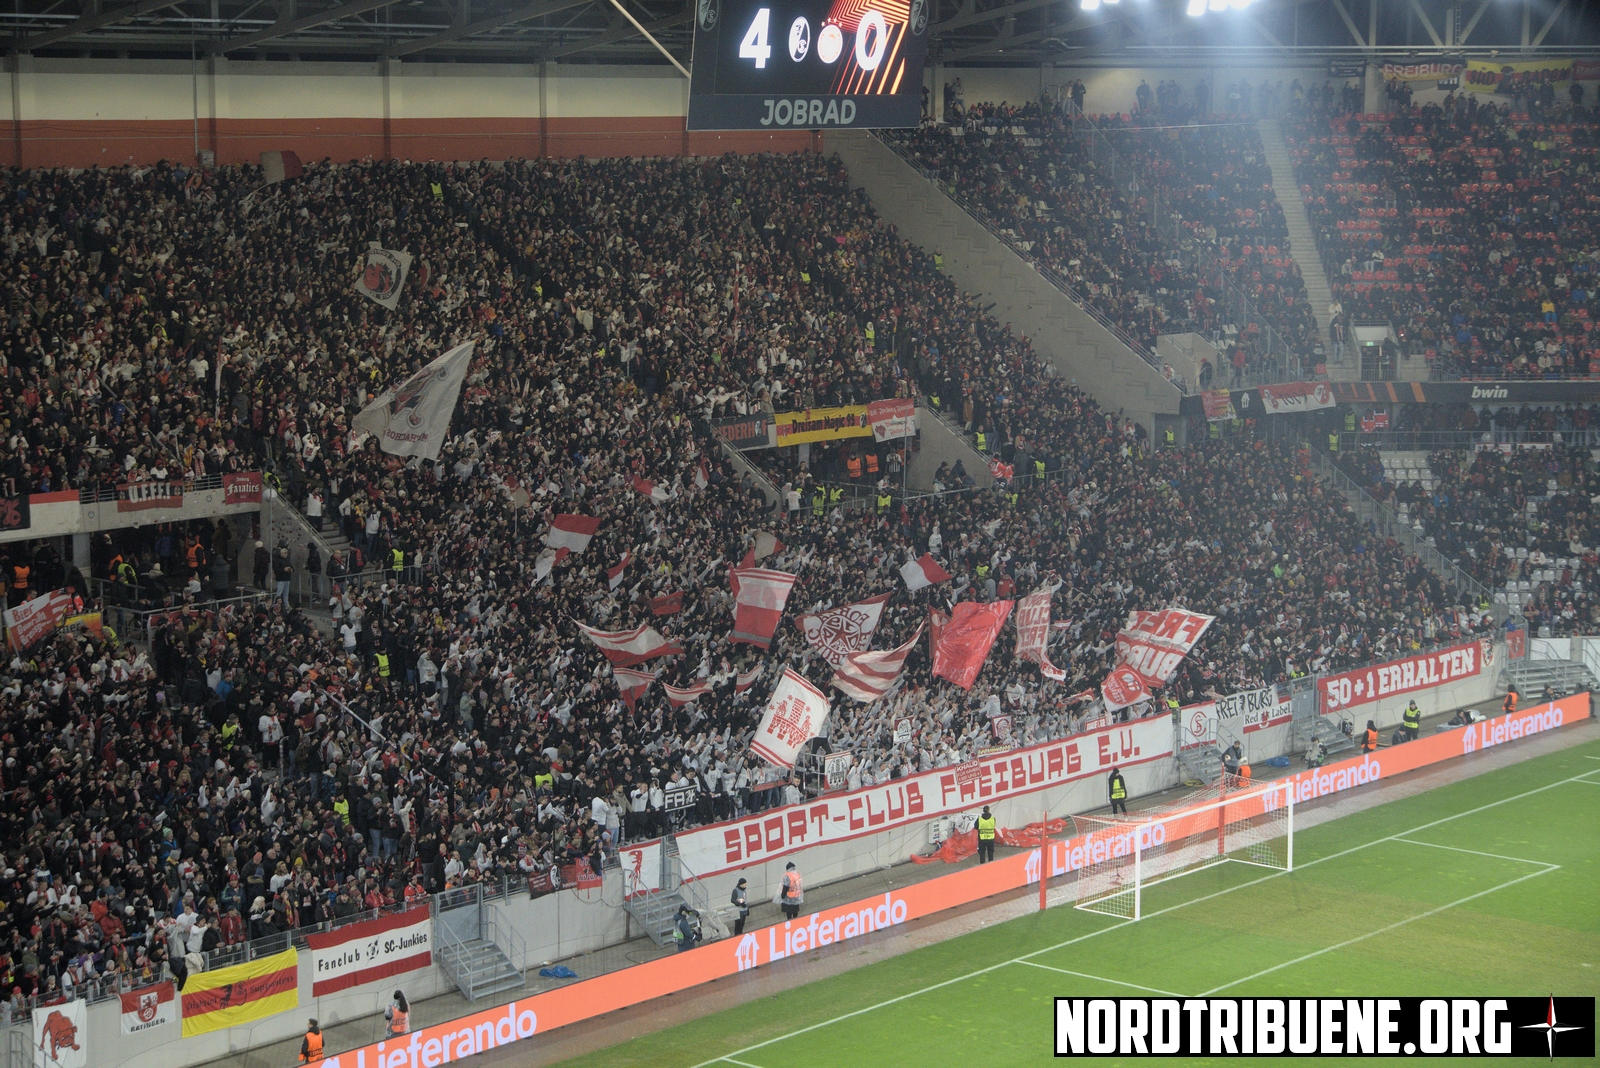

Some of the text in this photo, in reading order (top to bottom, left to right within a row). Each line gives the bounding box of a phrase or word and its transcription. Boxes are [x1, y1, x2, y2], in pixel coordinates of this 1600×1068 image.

[739, 8, 771, 69] 4
[855, 10, 887, 71] 0
[1383, 63, 1463, 80] FREIBURG
[760, 99, 857, 126] JOBRAD
[1471, 385, 1508, 399] bwin
[792, 418, 823, 434] Dreisam
[824, 414, 845, 433] Magic
[226, 482, 260, 497] Fanatics
[12, 604, 34, 622] Bier
[1378, 647, 1475, 693] ERHALTEN
[1244, 702, 1292, 725] Red Label
[1481, 701, 1563, 749] Lieferando
[940, 741, 1083, 807] FREIBURG
[956, 760, 983, 772] KHALID
[1284, 754, 1381, 806] Lieferando
[1051, 816, 1166, 877] Lieferando
[769, 891, 907, 962] Lieferando
[317, 931, 429, 973] Fanclub SC-Junkies
